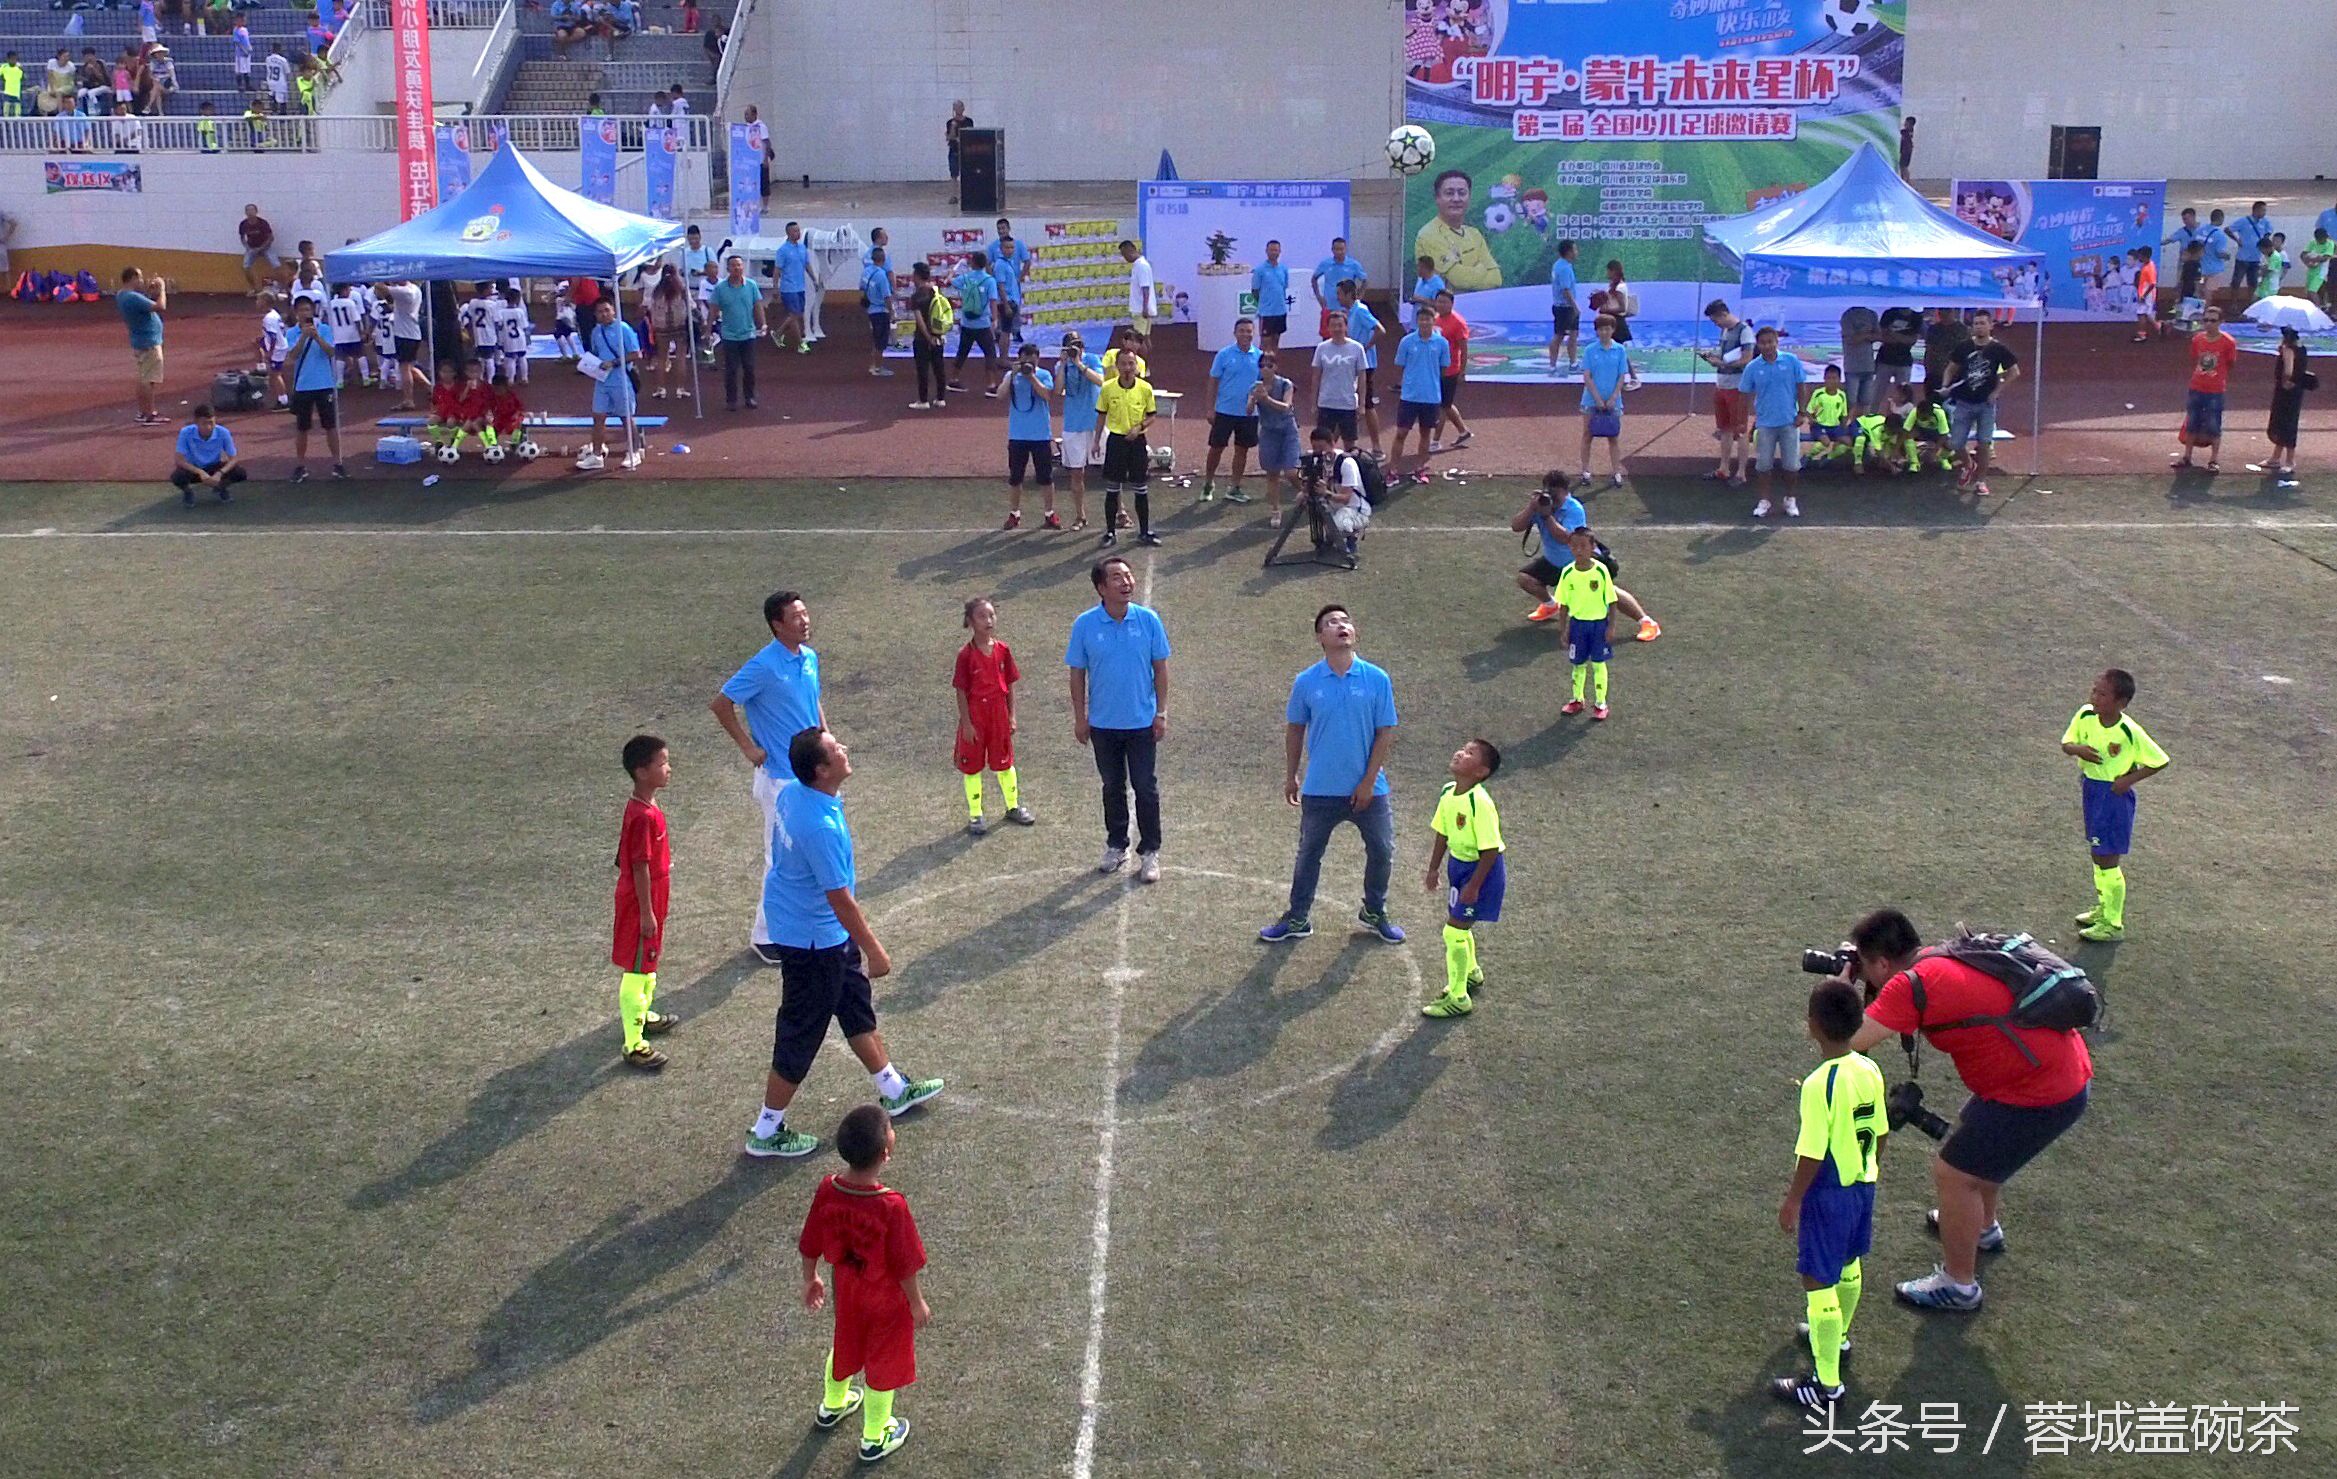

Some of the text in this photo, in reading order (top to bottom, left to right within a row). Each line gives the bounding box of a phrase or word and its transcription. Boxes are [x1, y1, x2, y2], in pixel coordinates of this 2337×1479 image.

[333, 306, 350, 327] 11
[475, 307, 486, 328] 2
[507, 318, 520, 339] 3
